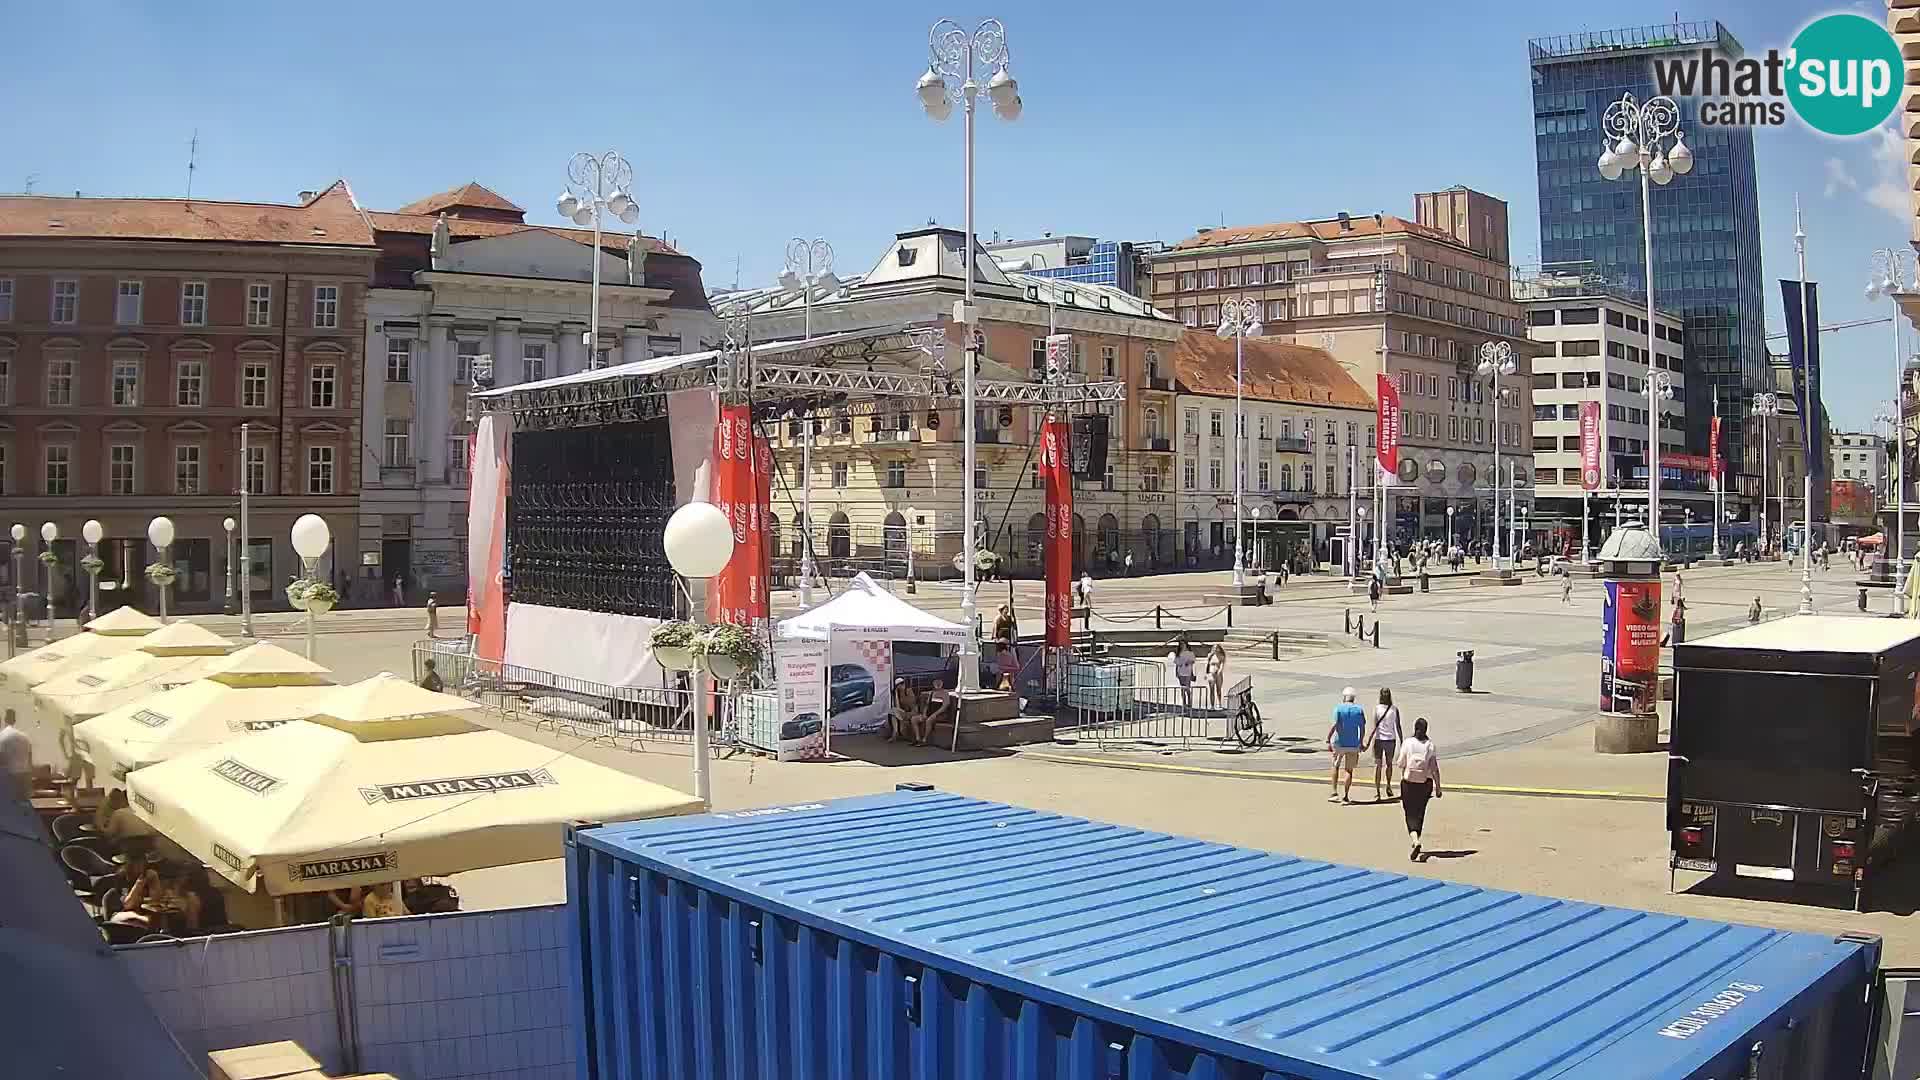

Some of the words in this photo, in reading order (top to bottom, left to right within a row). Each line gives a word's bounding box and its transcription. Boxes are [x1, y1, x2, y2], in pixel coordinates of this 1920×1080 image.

[1382, 396, 1390, 415] FANS
[1382, 418, 1390, 454] EMBASSY
[735, 501, 747, 544] Coca-Cola
[391, 772, 527, 800] MARASKA
[305, 857, 383, 877] MARASKA
